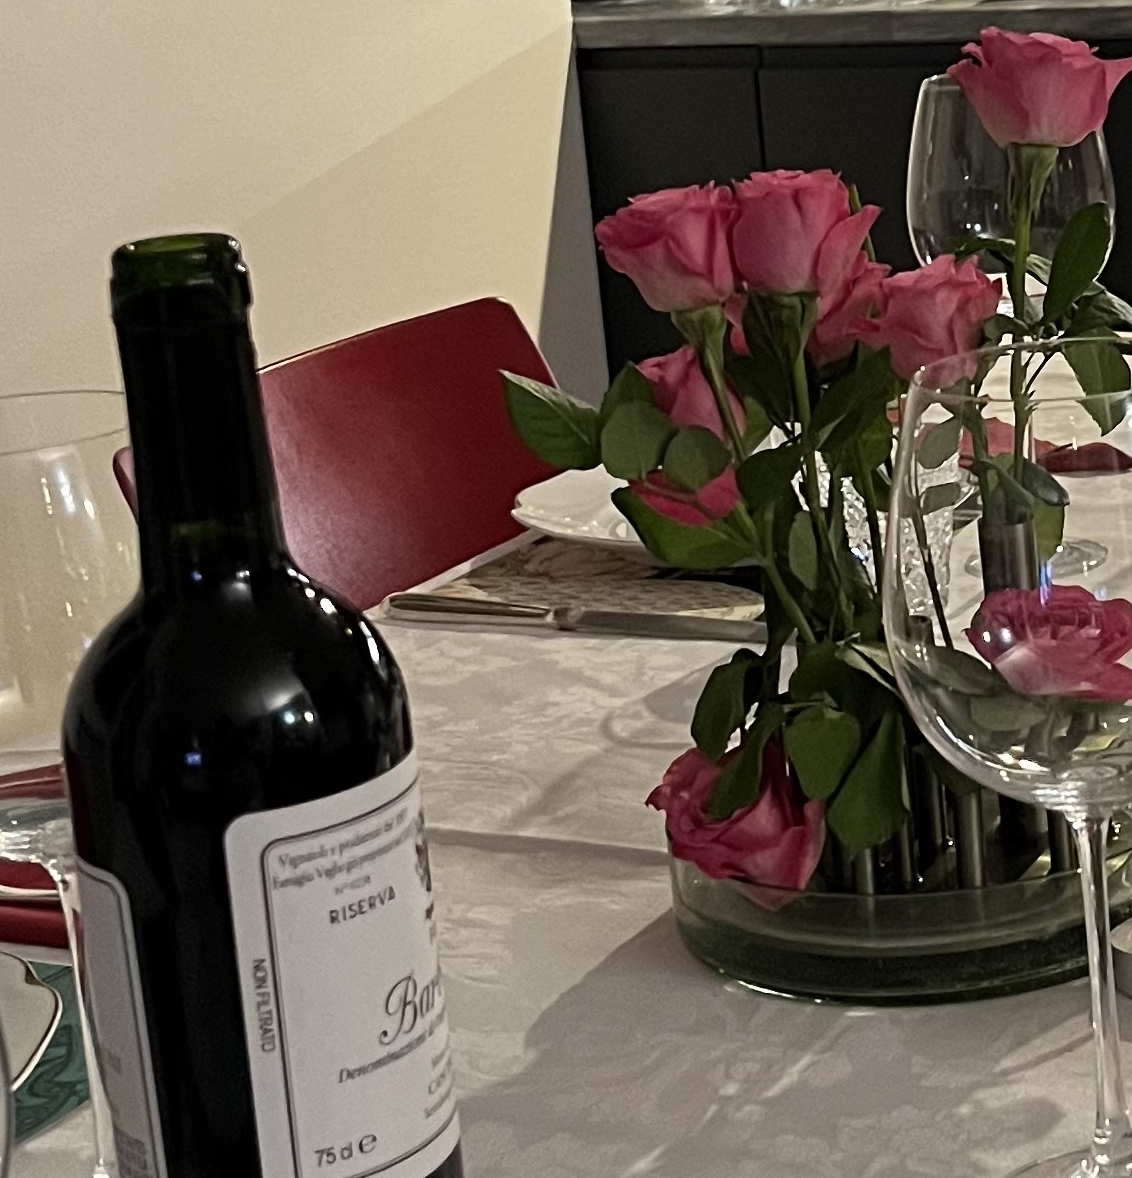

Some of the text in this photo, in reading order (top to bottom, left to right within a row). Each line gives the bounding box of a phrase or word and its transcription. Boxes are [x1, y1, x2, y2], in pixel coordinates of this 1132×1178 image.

[329, 885, 396, 924] RISERVA
[252, 957, 276, 1054] NON FILTRATO
[379, 968, 443, 1046] Bar
[315, 1146, 337, 1168] 75
